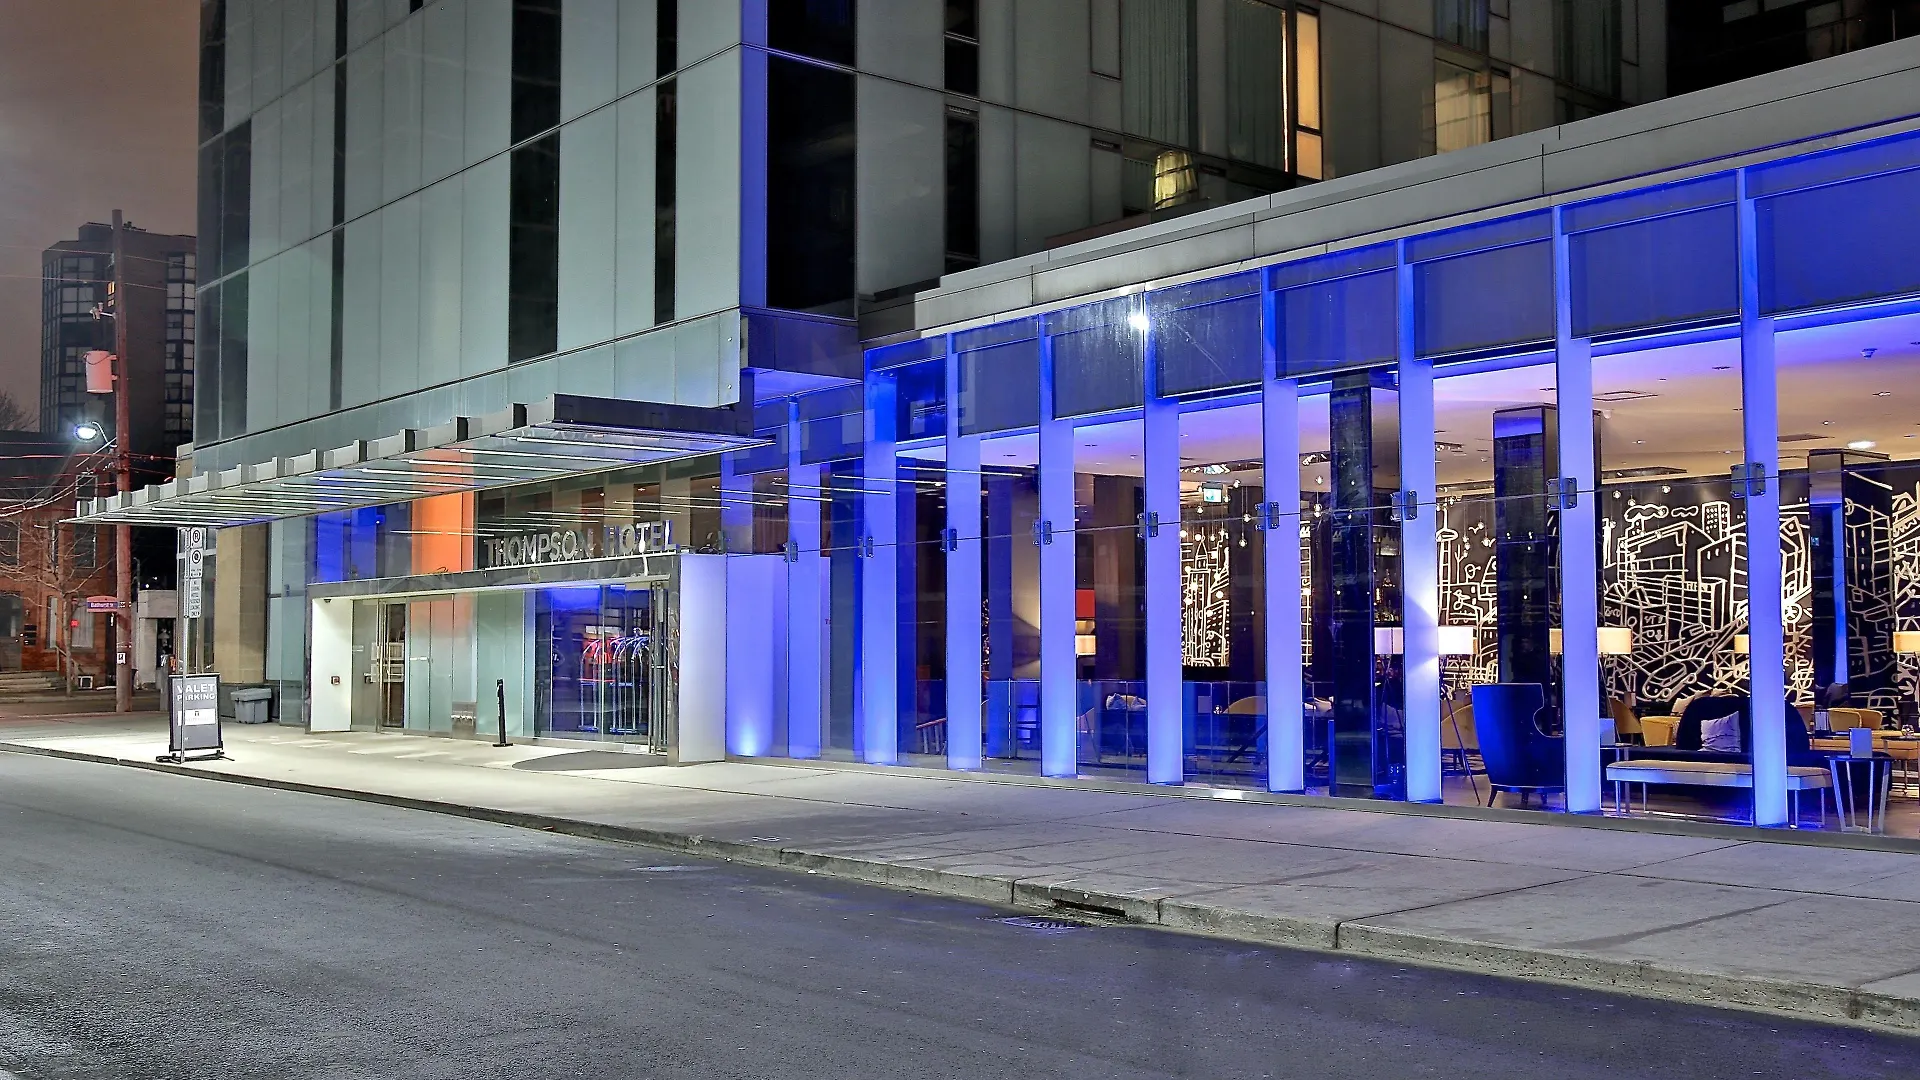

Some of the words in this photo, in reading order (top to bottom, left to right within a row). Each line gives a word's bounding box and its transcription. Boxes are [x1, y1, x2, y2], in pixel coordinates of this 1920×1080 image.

[484, 528, 595, 567] THOMPSON
[603, 519, 680, 557] HOTEL
[176, 683, 216, 694] VALET
